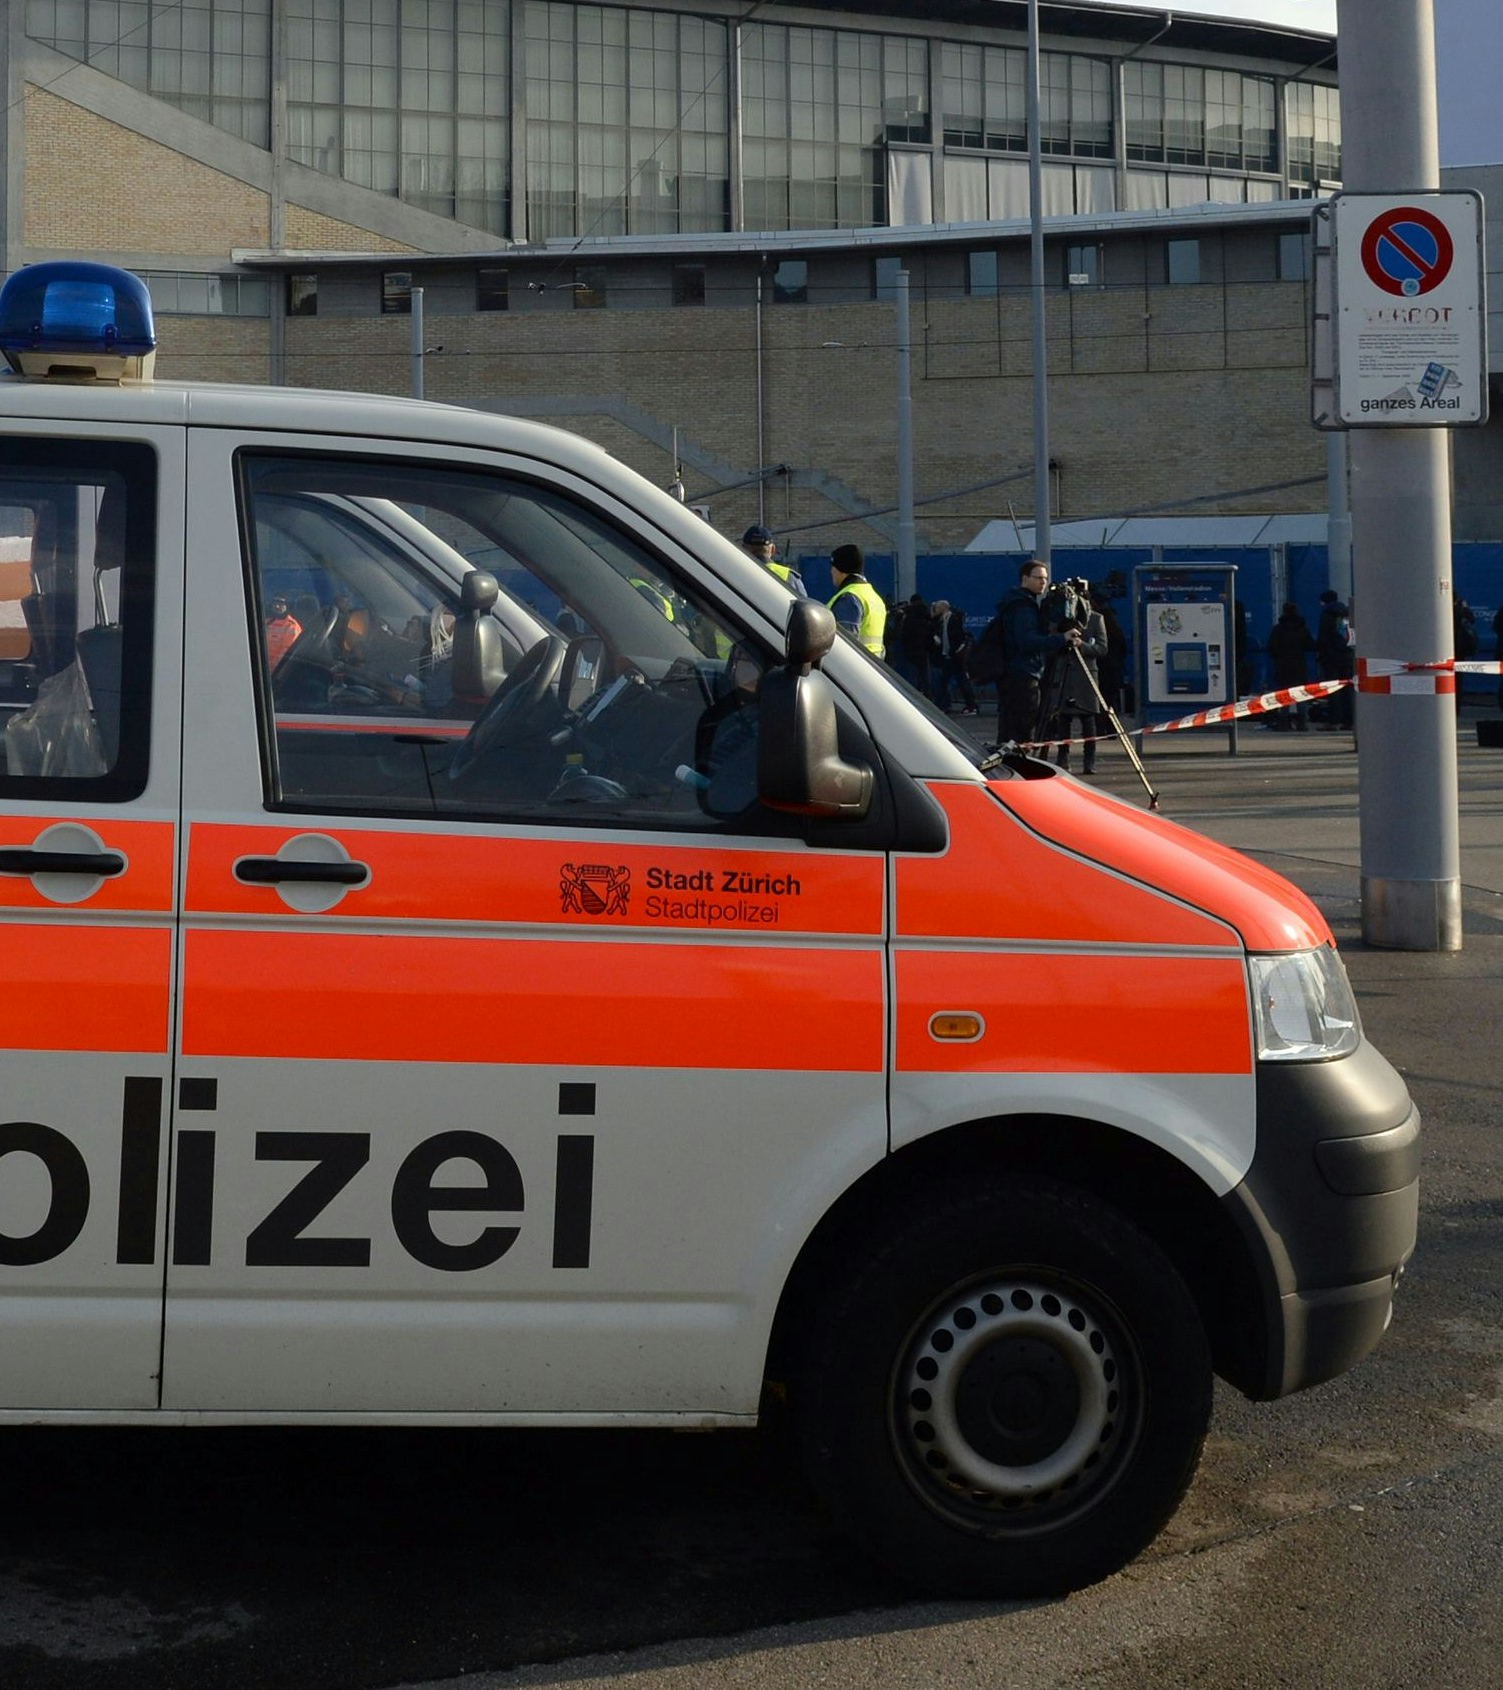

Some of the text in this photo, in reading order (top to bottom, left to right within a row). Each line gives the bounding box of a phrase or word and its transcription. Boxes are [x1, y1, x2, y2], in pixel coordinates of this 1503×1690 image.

[1360, 396, 1460, 412] ganzes Areal
[646, 867, 801, 896] Stadt Zürich
[645, 896, 779, 925] Stadtpolizei
